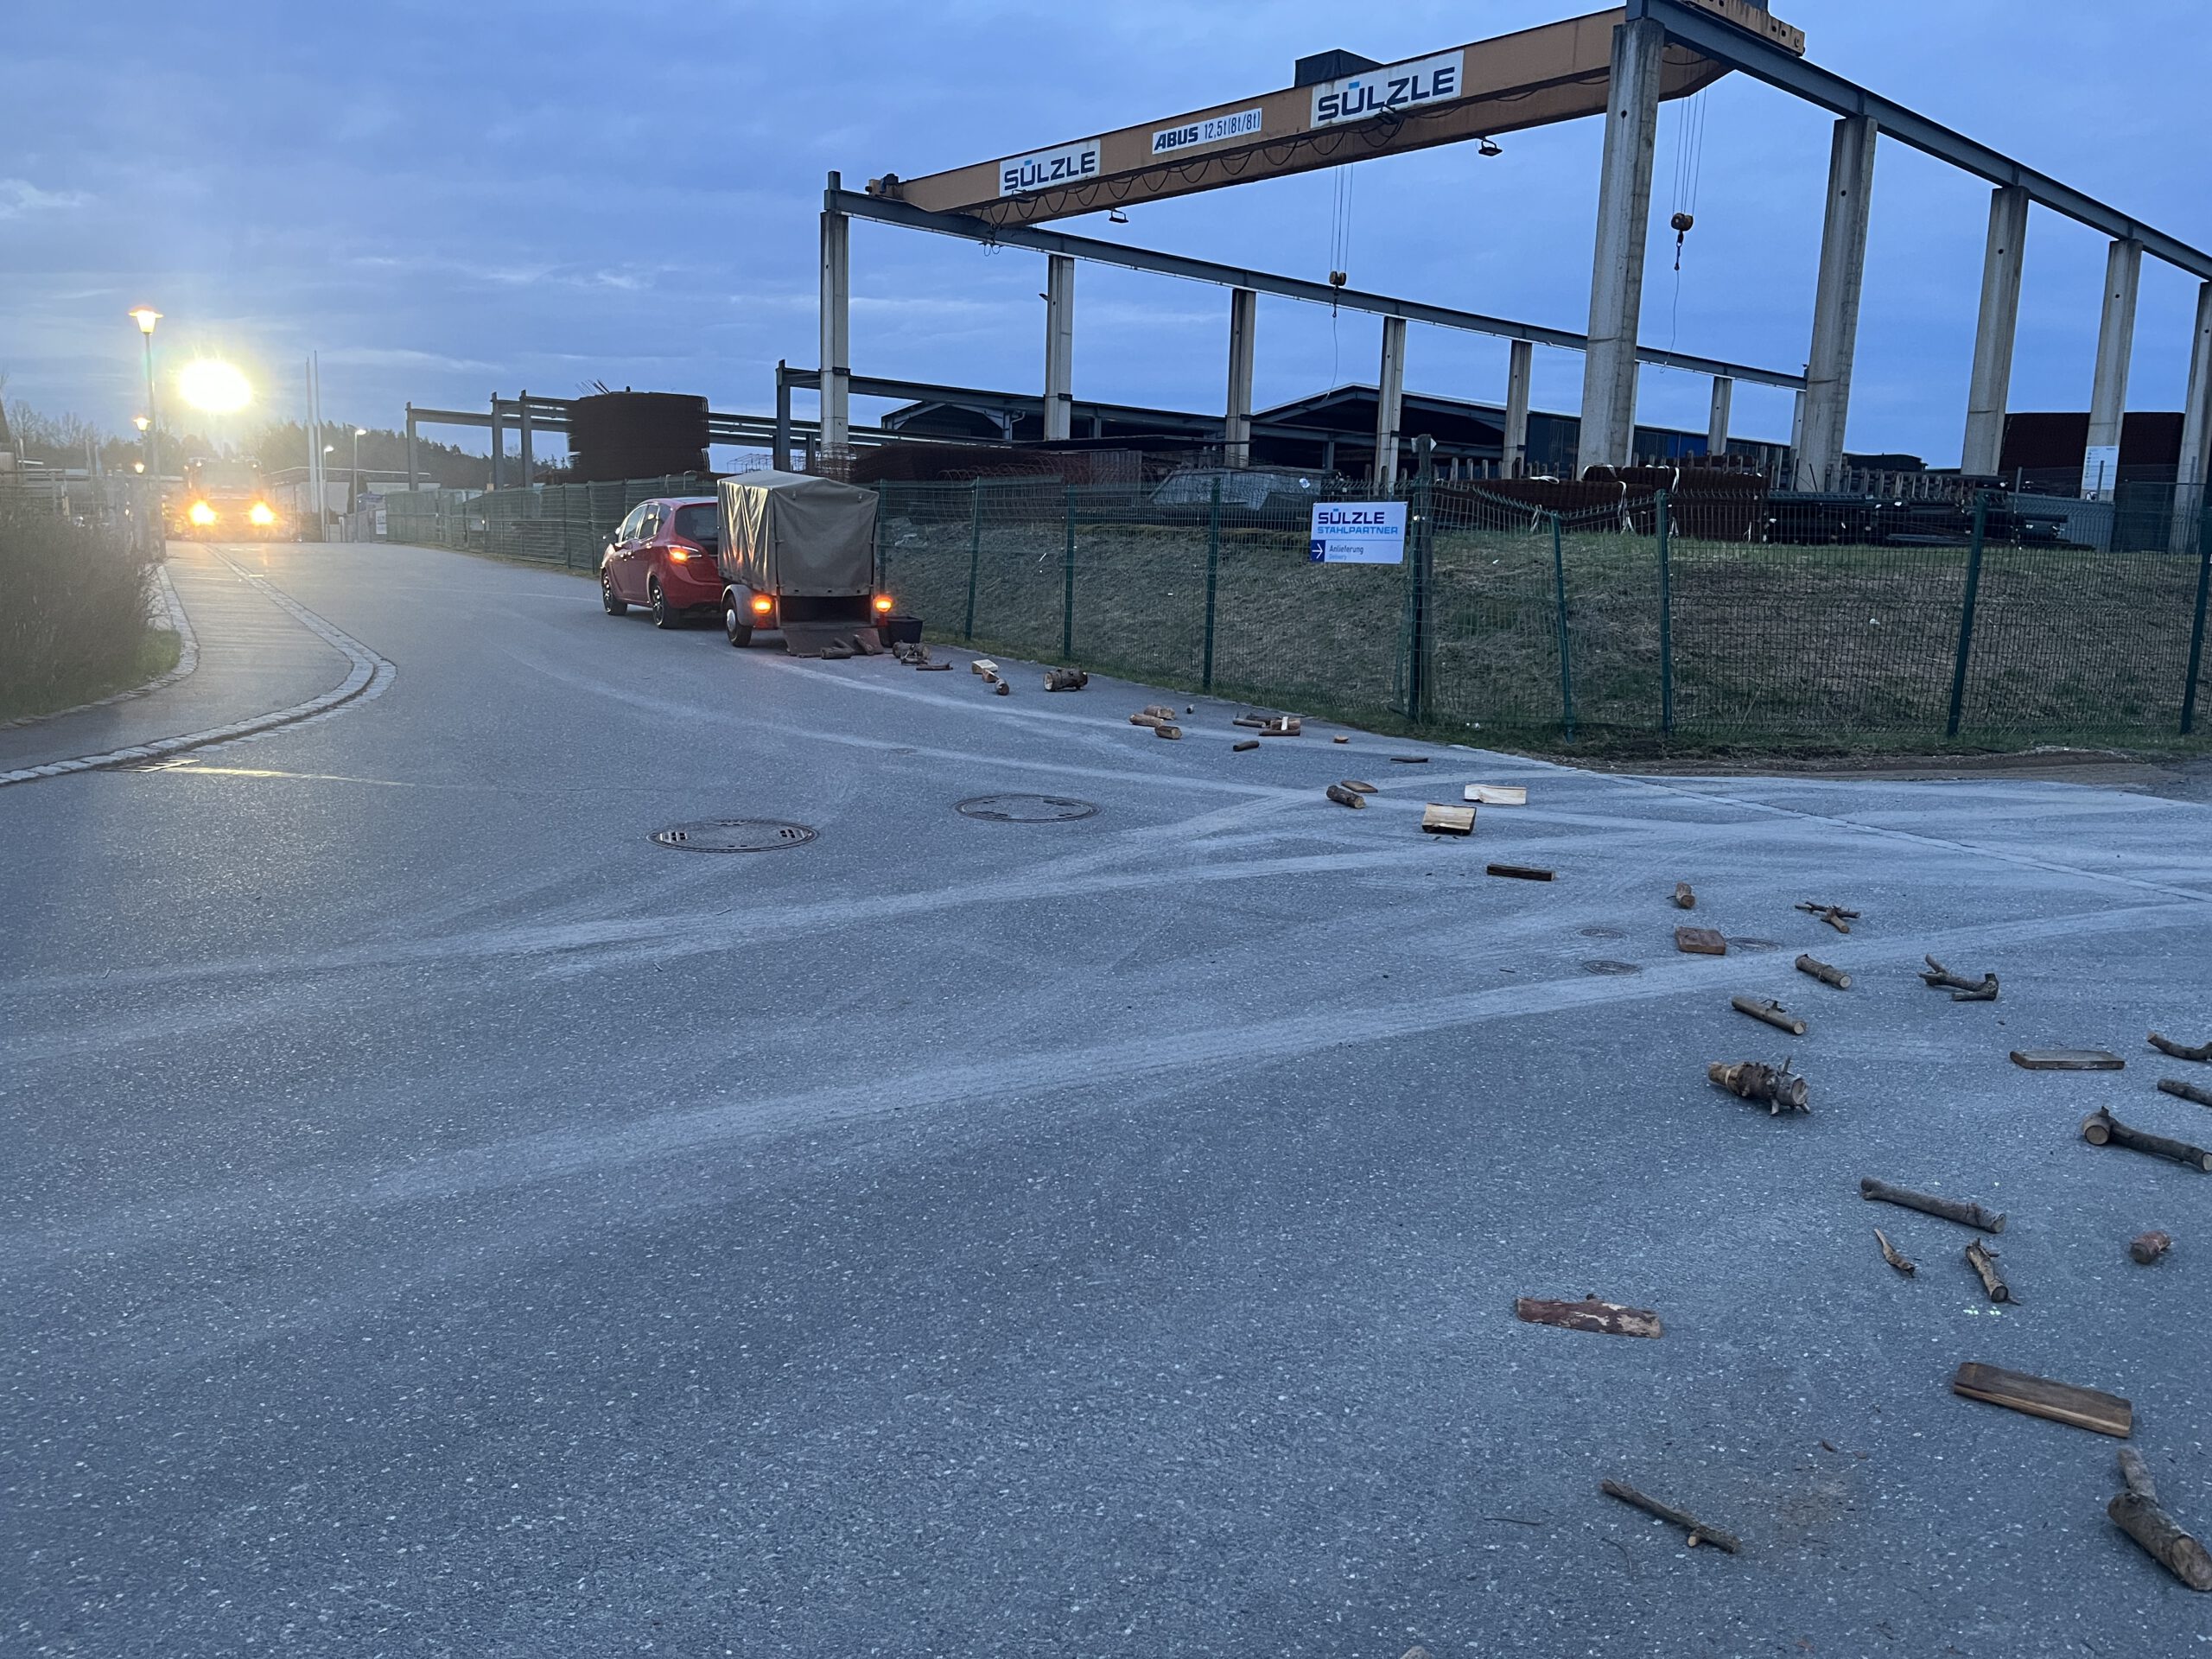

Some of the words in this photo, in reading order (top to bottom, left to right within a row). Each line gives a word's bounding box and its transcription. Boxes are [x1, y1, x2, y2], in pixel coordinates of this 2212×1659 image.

[1318, 67, 1455, 121] SÜLZLE
[1154, 126, 1198, 150] ABUS
[1004, 150, 1096, 191] SÜLZLE
[1318, 508, 1385, 524] SÜLZLE
[1317, 526, 1398, 535] STAHLPARTNER
[1329, 545, 1364, 556] Anlieferung
